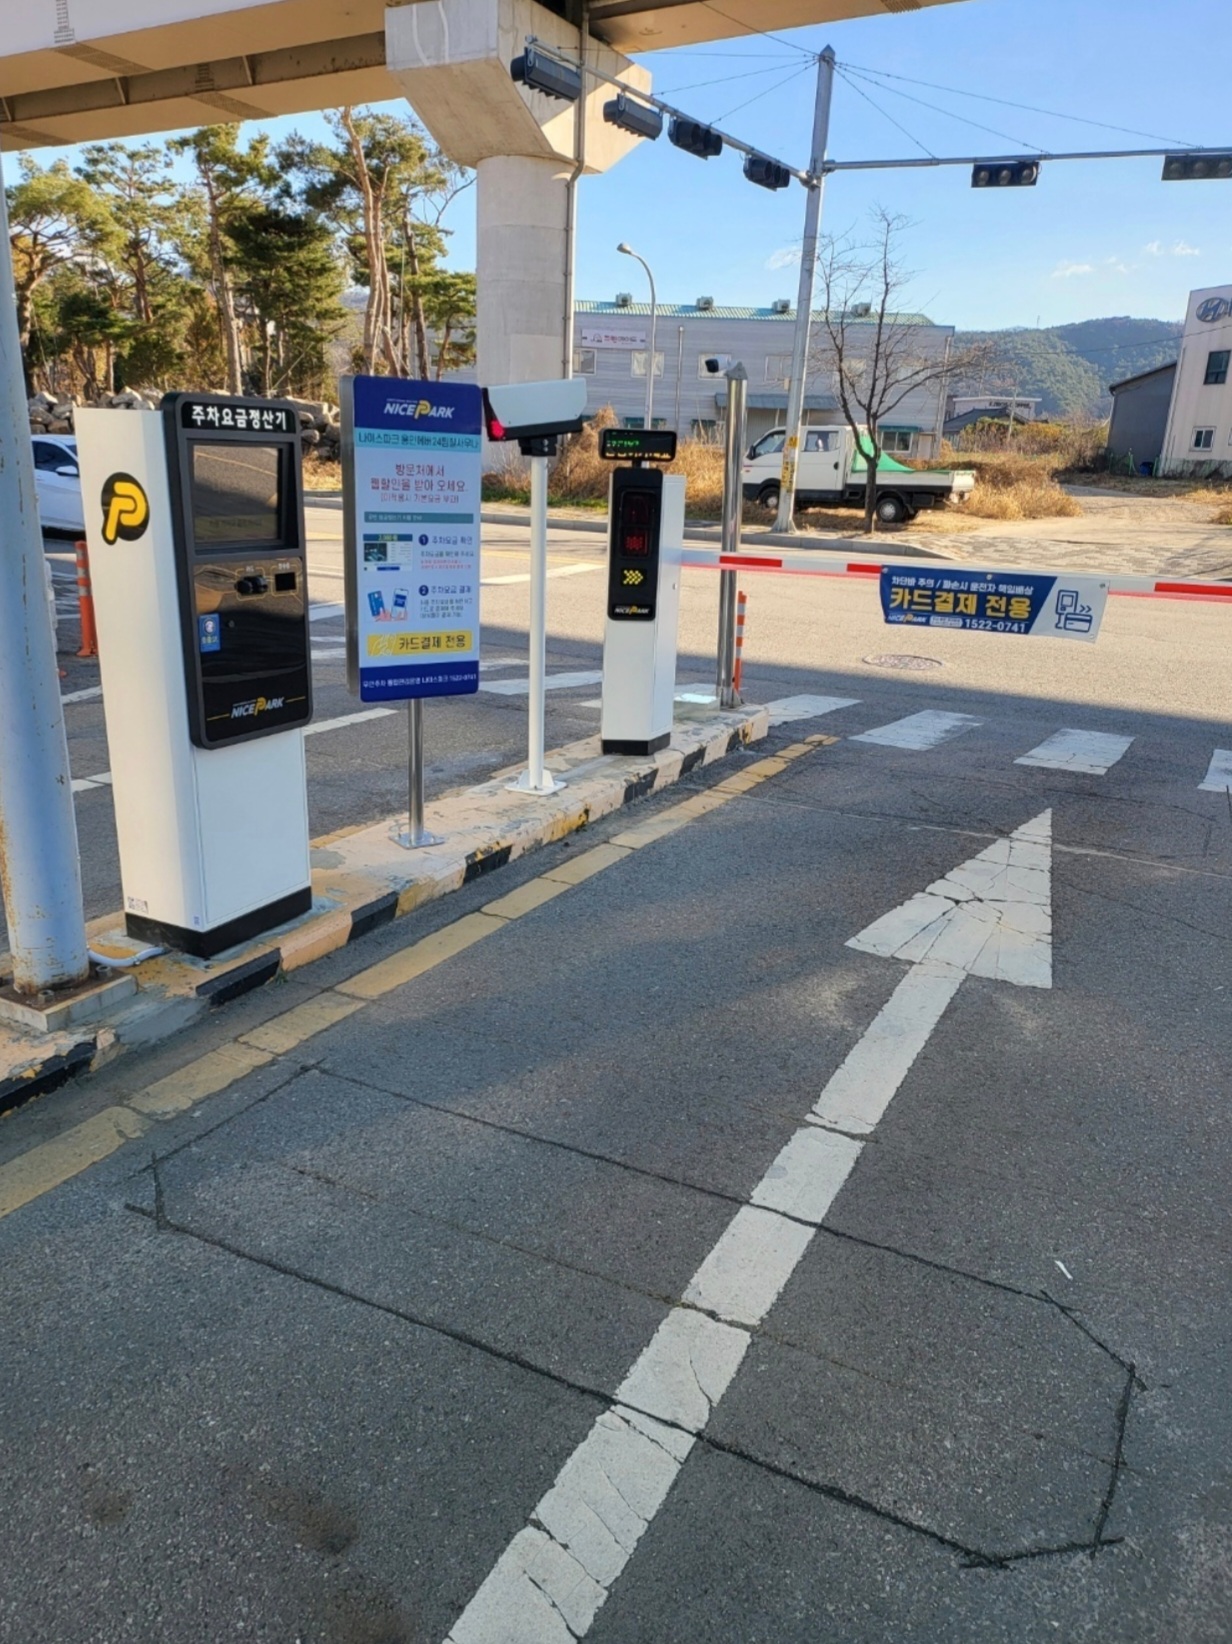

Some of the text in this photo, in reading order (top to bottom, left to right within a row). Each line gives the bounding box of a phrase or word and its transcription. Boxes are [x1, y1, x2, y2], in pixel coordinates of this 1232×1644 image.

[191, 405, 287, 430] 주차요금정산기
[358, 431, 399, 444] 나이스파크
[395, 463, 445, 477] 방문처에서
[371, 477, 411, 491] 웹할인을
[414, 479, 434, 491] 받아
[432, 535, 458, 545] 주차요금
[460, 535, 473, 545] 확인
[431, 585, 457, 594] 주차요금
[459, 585, 471, 594] 결제
[917, 577, 935, 588] 주의
[970, 581, 996, 593] 운전자
[889, 587, 1032, 619] 카드결제 전용
[965, 618, 1026, 633] 1522-0741
[398, 634, 466, 650] 카드결제 전용
